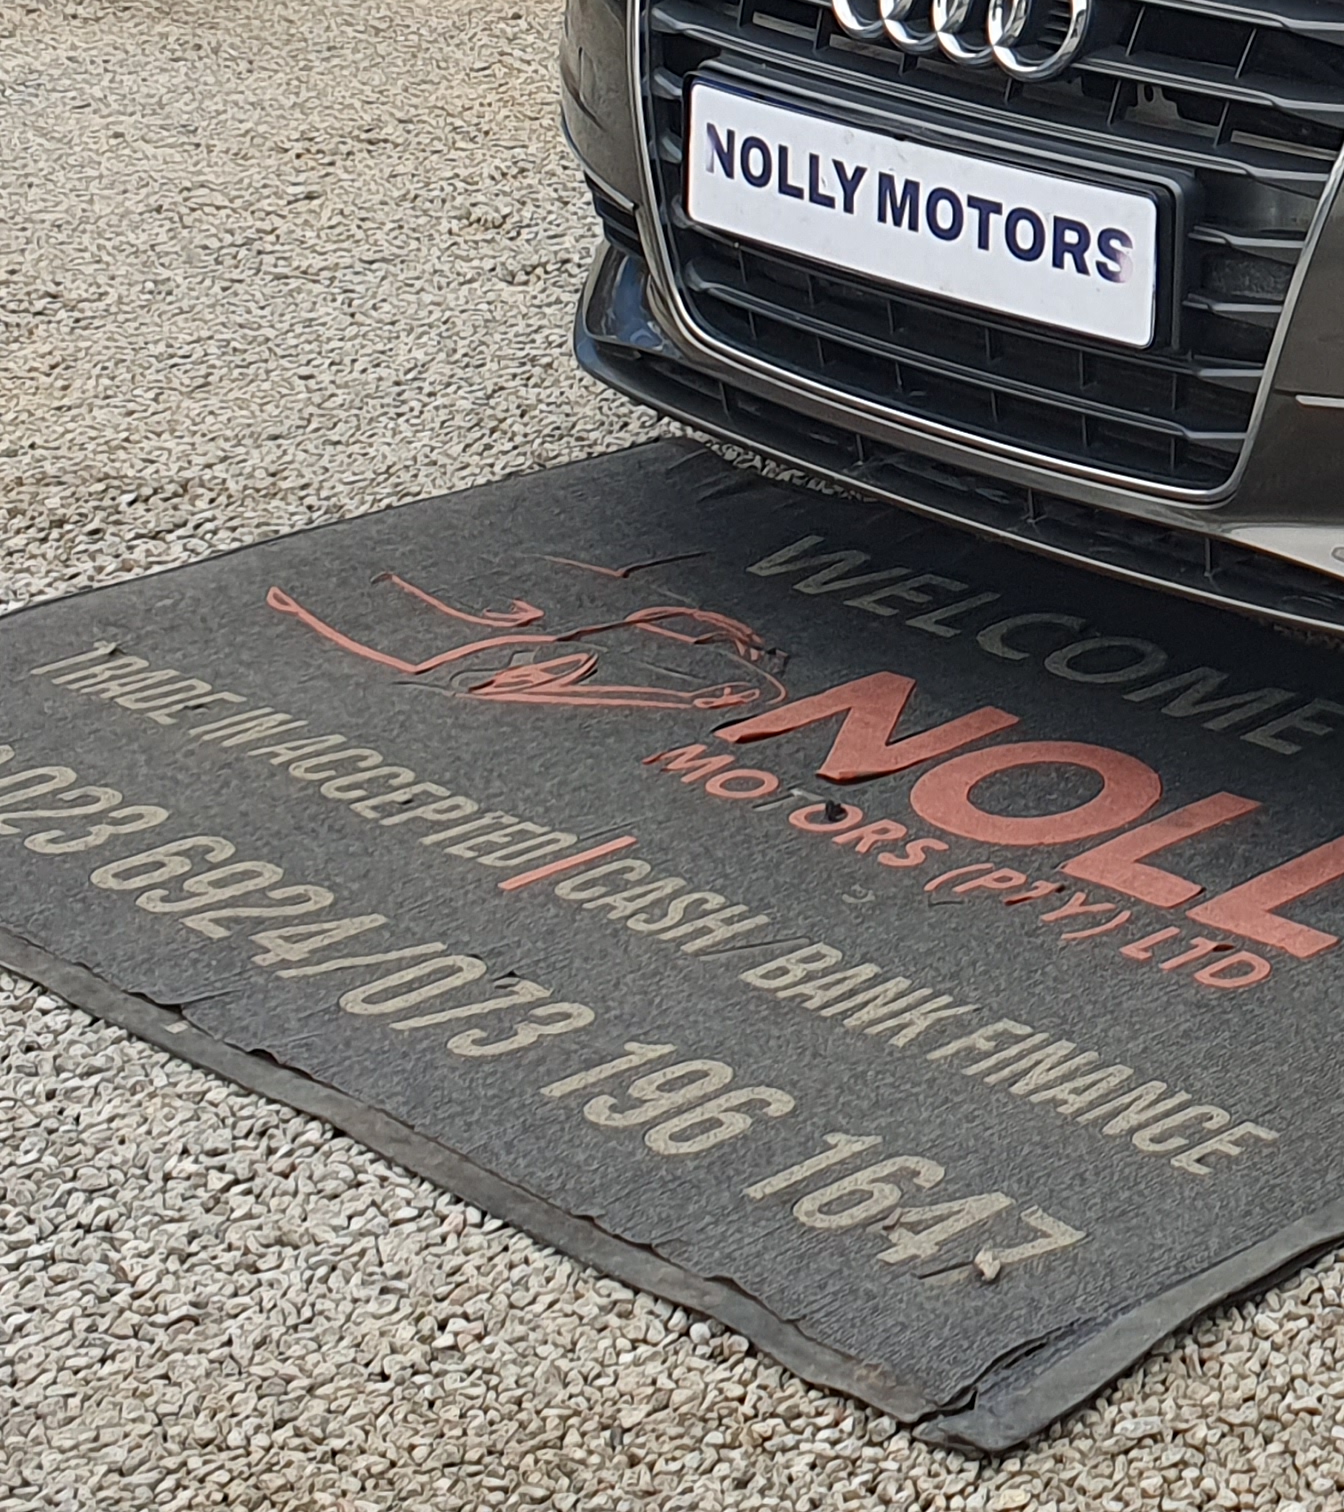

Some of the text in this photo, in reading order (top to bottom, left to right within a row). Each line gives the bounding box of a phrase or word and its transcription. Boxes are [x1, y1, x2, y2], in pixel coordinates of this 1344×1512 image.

[705, 121, 1135, 285] NOLLY MOTORS
[30, 640, 248, 726] TRADE
[188, 706, 309, 748] IN
[926, 1019, 1280, 1176] FINANCE
[642, 743, 950, 868] MOTORS
[1120, 925, 1272, 988] LTD
[540, 1041, 796, 1158] 196
[742, 1132, 1087, 1281] 1647
